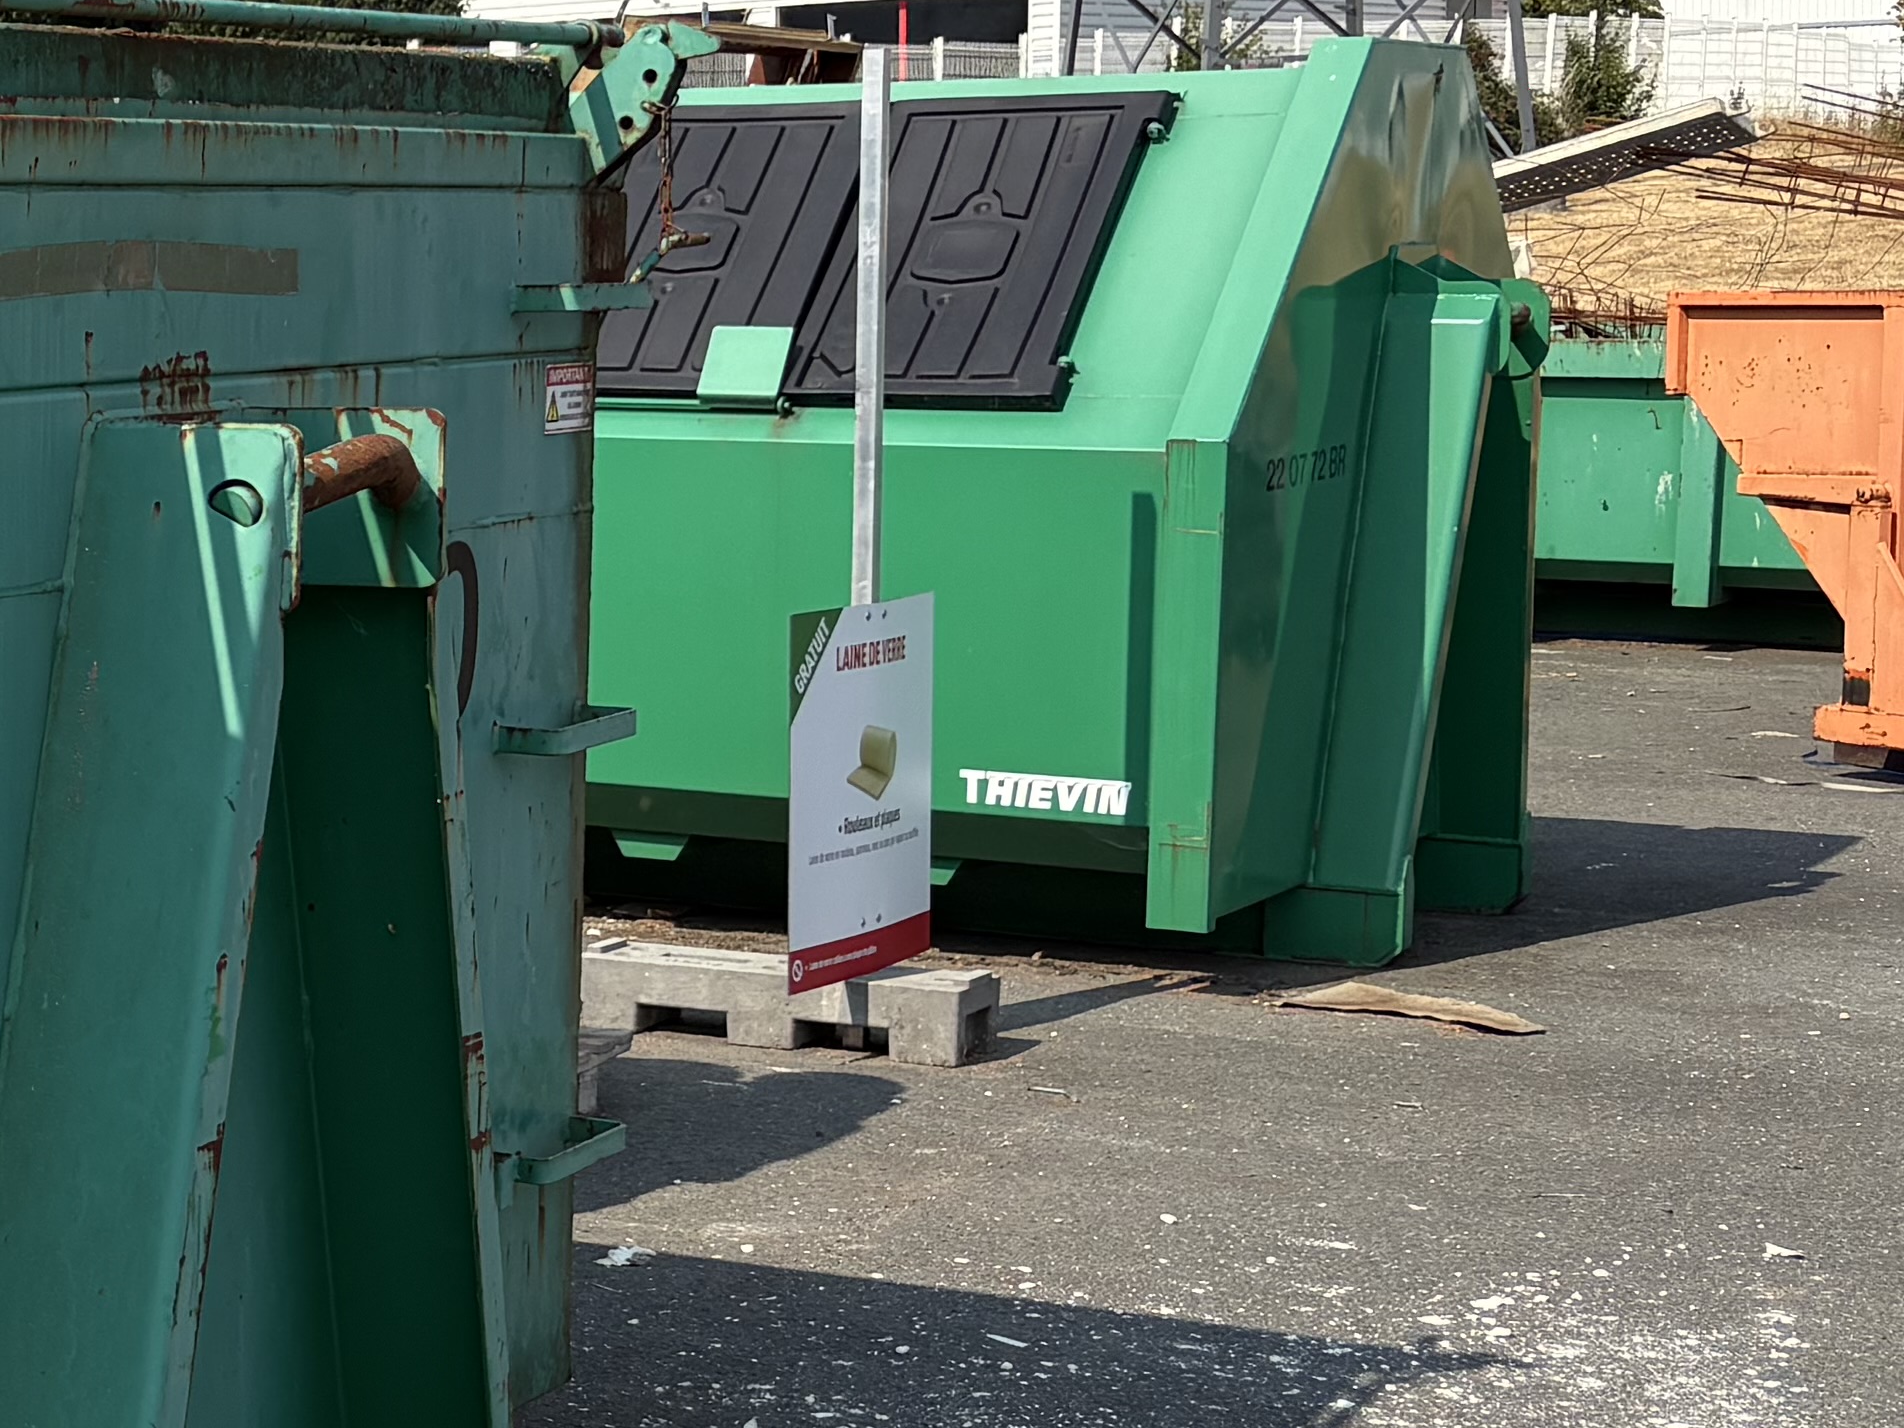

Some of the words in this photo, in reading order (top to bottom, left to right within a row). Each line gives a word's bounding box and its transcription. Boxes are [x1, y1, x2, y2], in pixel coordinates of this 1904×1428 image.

[1266, 457, 1286, 492] 22
[794, 616, 830, 694] GRATUIT
[836, 642, 868, 672] LAINE
[869, 640, 881, 667] DE
[882, 635, 907, 664] VERRE
[959, 768, 1133, 816] THIEVIN
